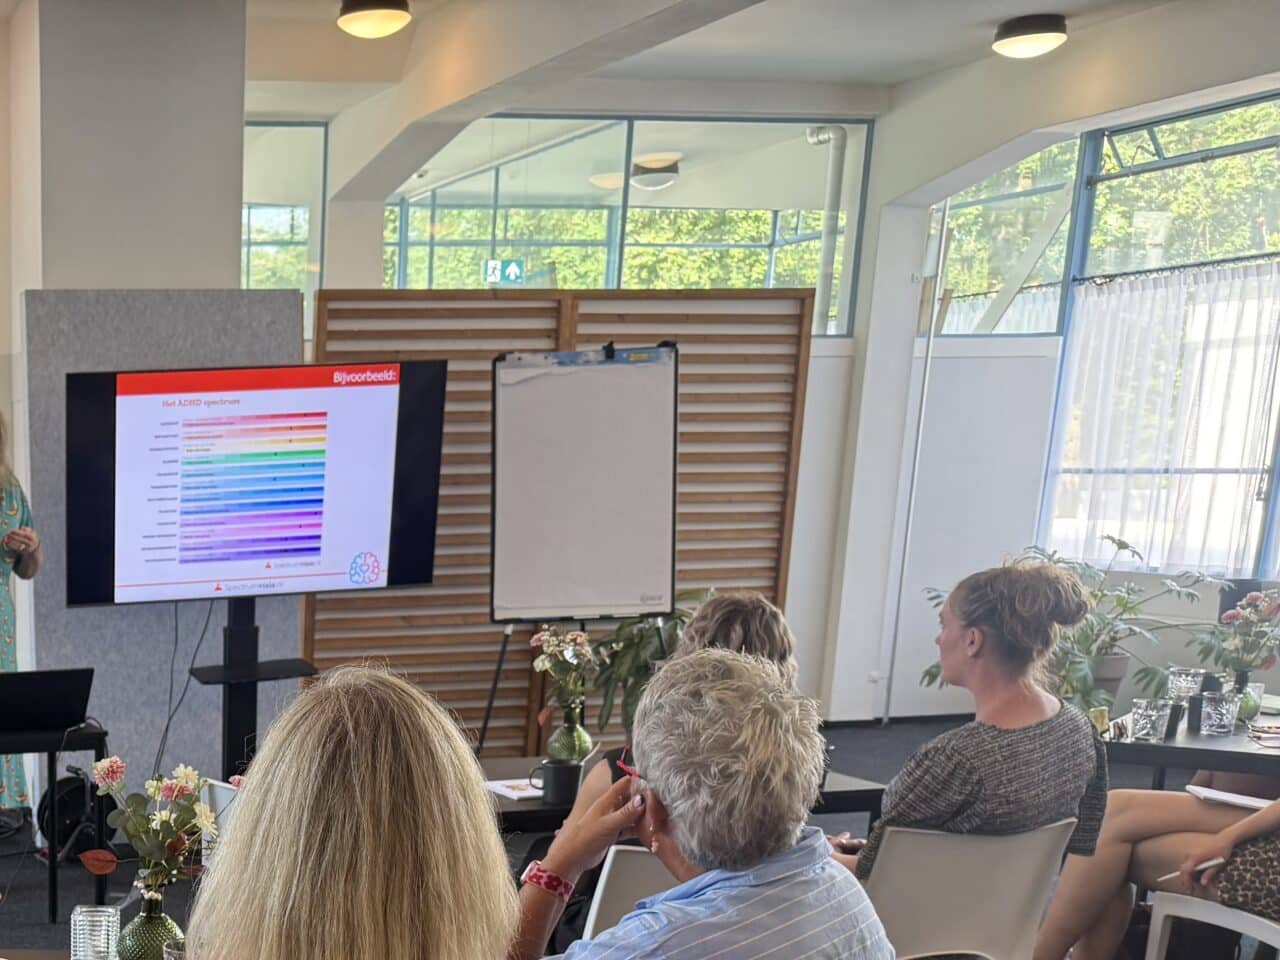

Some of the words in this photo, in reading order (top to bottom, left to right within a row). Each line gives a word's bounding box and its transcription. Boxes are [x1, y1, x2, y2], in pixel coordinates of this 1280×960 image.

[333, 369, 397, 385] Bijvoorbeeld:
[177, 398, 202, 408] ADHD
[203, 397, 240, 409] spectrum
